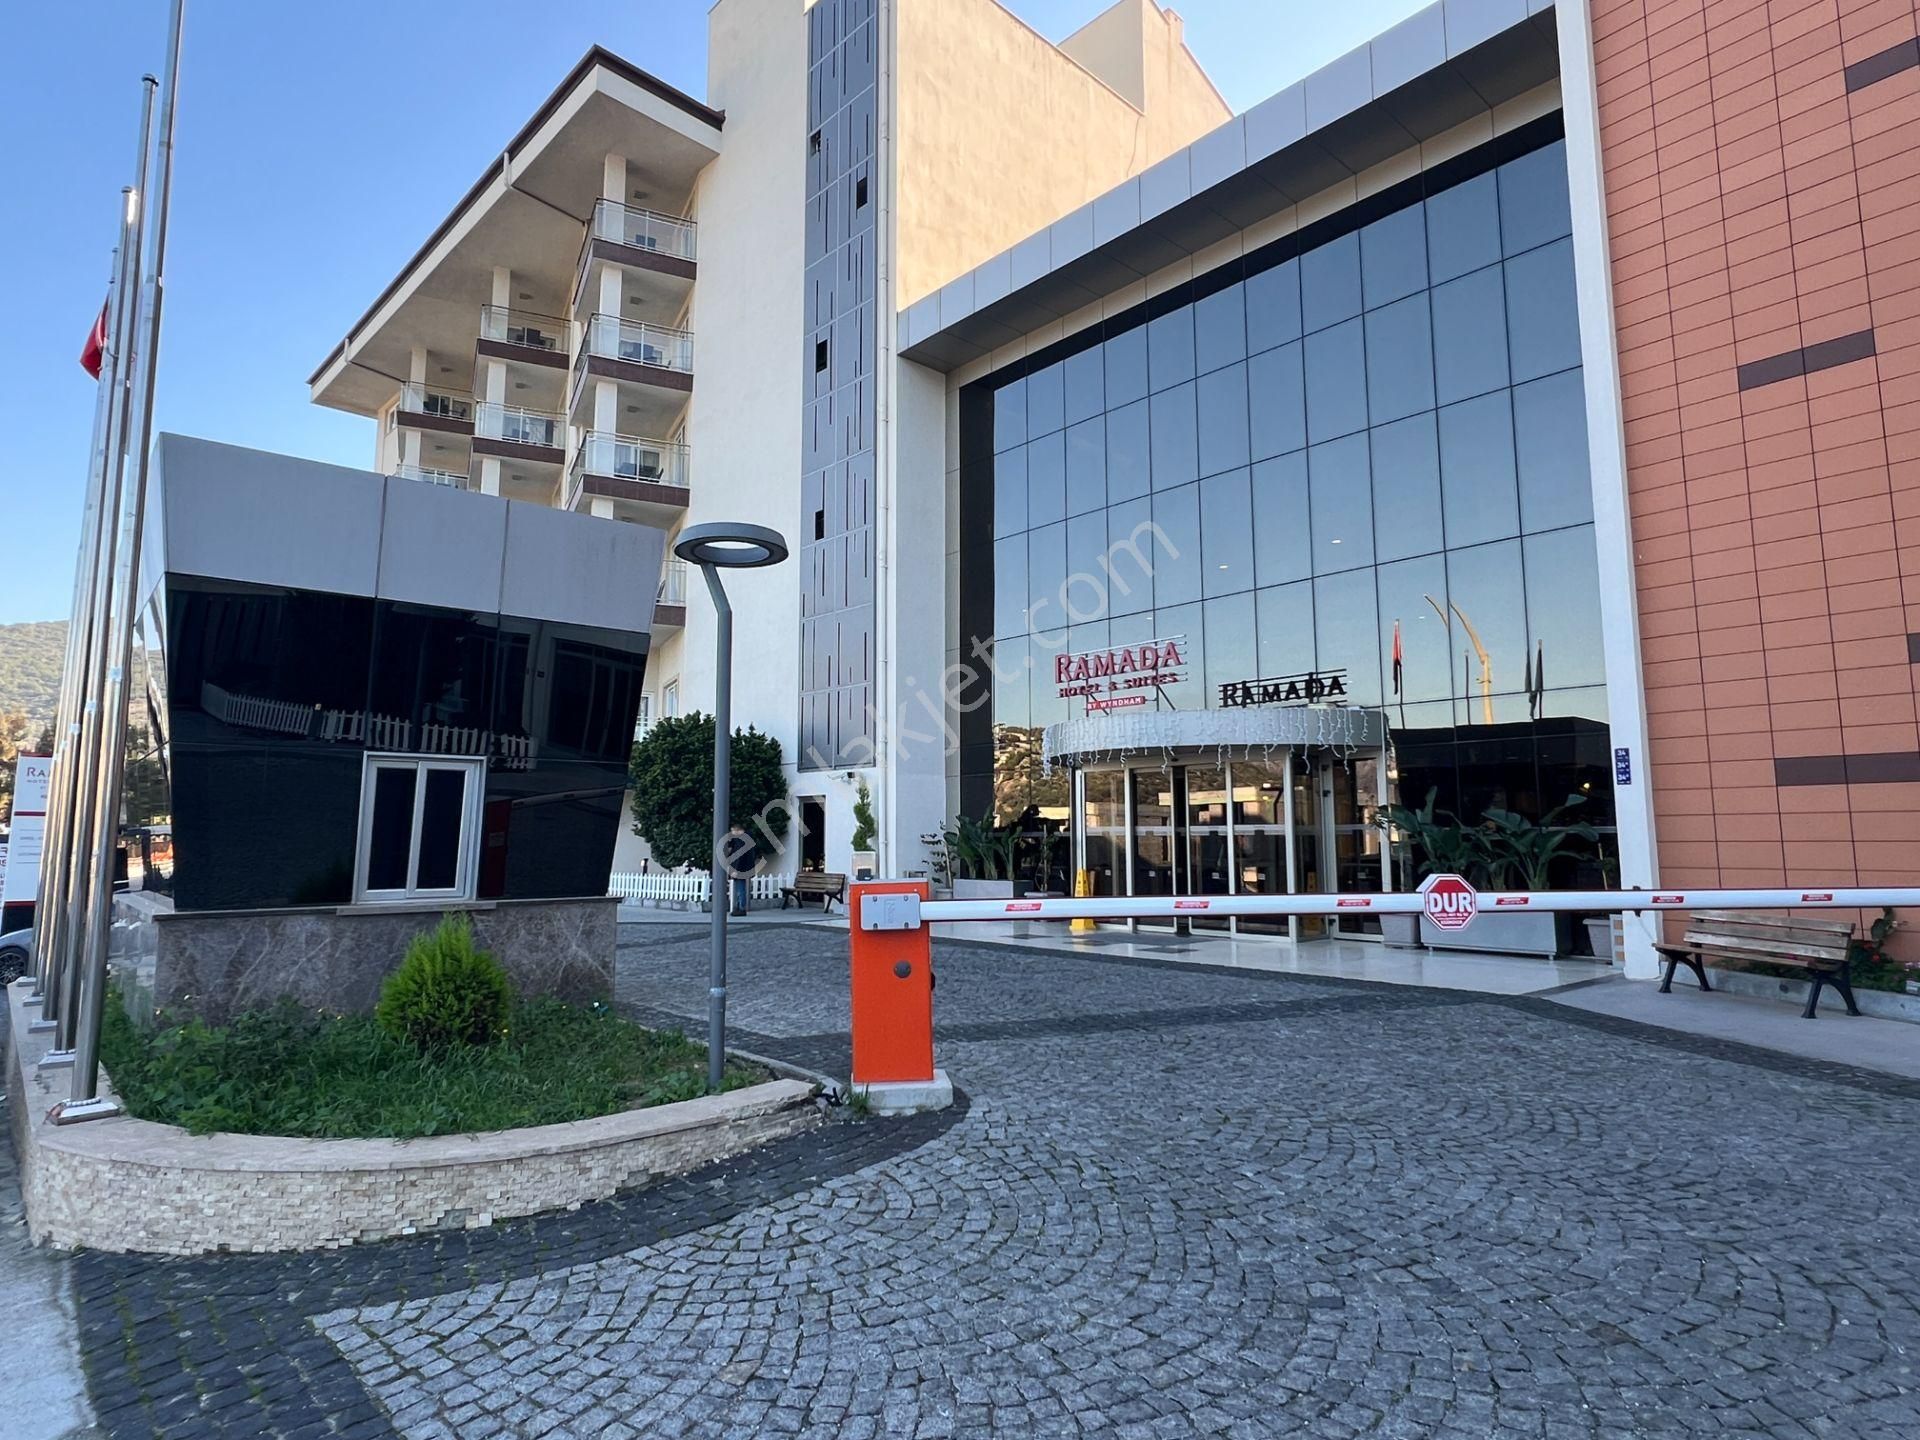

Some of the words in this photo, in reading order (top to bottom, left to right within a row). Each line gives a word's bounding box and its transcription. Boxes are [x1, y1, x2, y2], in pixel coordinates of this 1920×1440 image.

[1055, 641, 1182, 683] RAMADA
[1059, 683, 1102, 698] HOTEL
[1109, 681, 1118, 691] &
[1124, 672, 1179, 689] SUITES
[1222, 675, 1345, 707] RAMADA
[1087, 700, 1098, 709] BY
[1100, 697, 1142, 708] WYNDHAM
[1429, 892, 1473, 912] DUR
